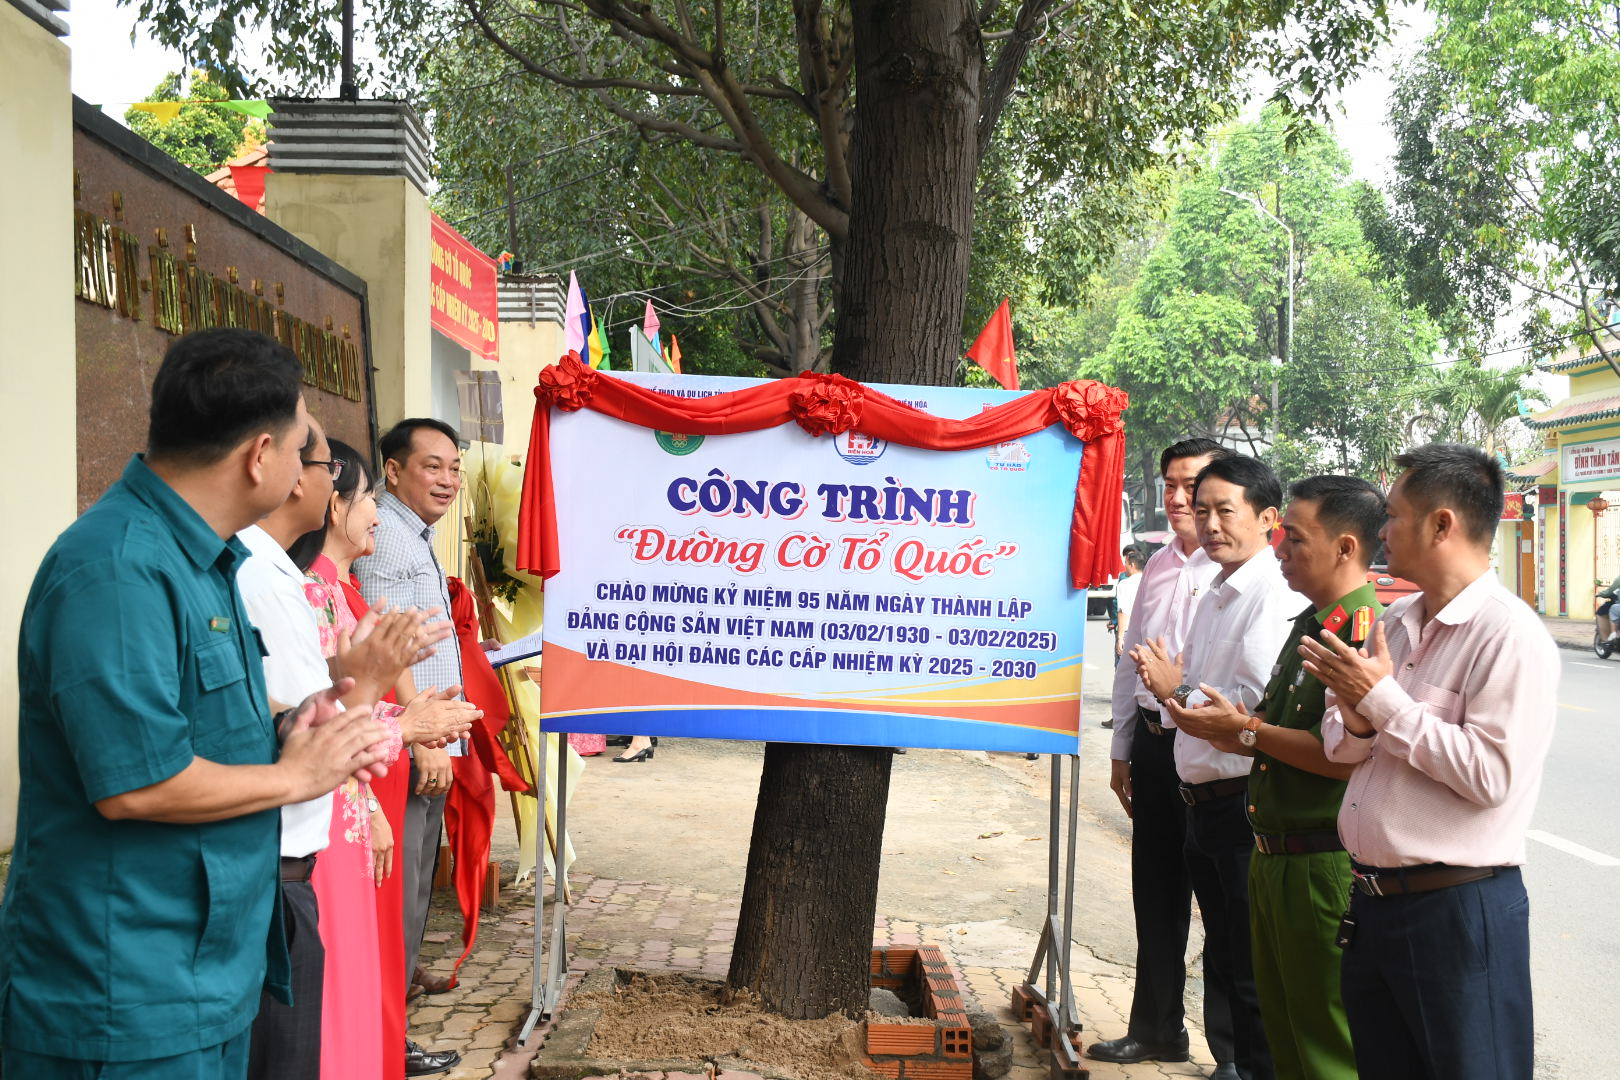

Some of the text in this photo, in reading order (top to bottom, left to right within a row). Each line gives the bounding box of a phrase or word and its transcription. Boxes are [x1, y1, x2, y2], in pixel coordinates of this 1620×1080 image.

[667, 467, 974, 526] CÔNG TRÌNH
[777, 534, 832, 569] Cờ
[841, 531, 890, 571] Tổ
[596, 580, 1032, 622] CHÀO MỪNG KỶ NIỆM 95 NĂM NGÀY THÀNH LẬP
[567, 606, 619, 631] ĐẢNG
[624, 610, 676, 636] CỘNG
[681, 611, 721, 635] SẢN
[726, 615, 766, 640] VIỆT
[770, 620, 814, 639] NAM
[820, 622, 930, 645] (03/02/1930
[948, 628, 1057, 652] 03/02/2025)
[586, 638, 610, 660] VÀ
[615, 642, 647, 665] ĐẠI
[652, 641, 684, 667] HỘI
[689, 641, 741, 665] ĐẢNG
[746, 645, 784, 668] CÁC
[789, 645, 827, 669] CẤP
[832, 650, 893, 676] NHIỆM
[899, 654, 923, 674] KỲ
[928, 657, 973, 676] 2025
[991, 660, 1037, 679] 2030
